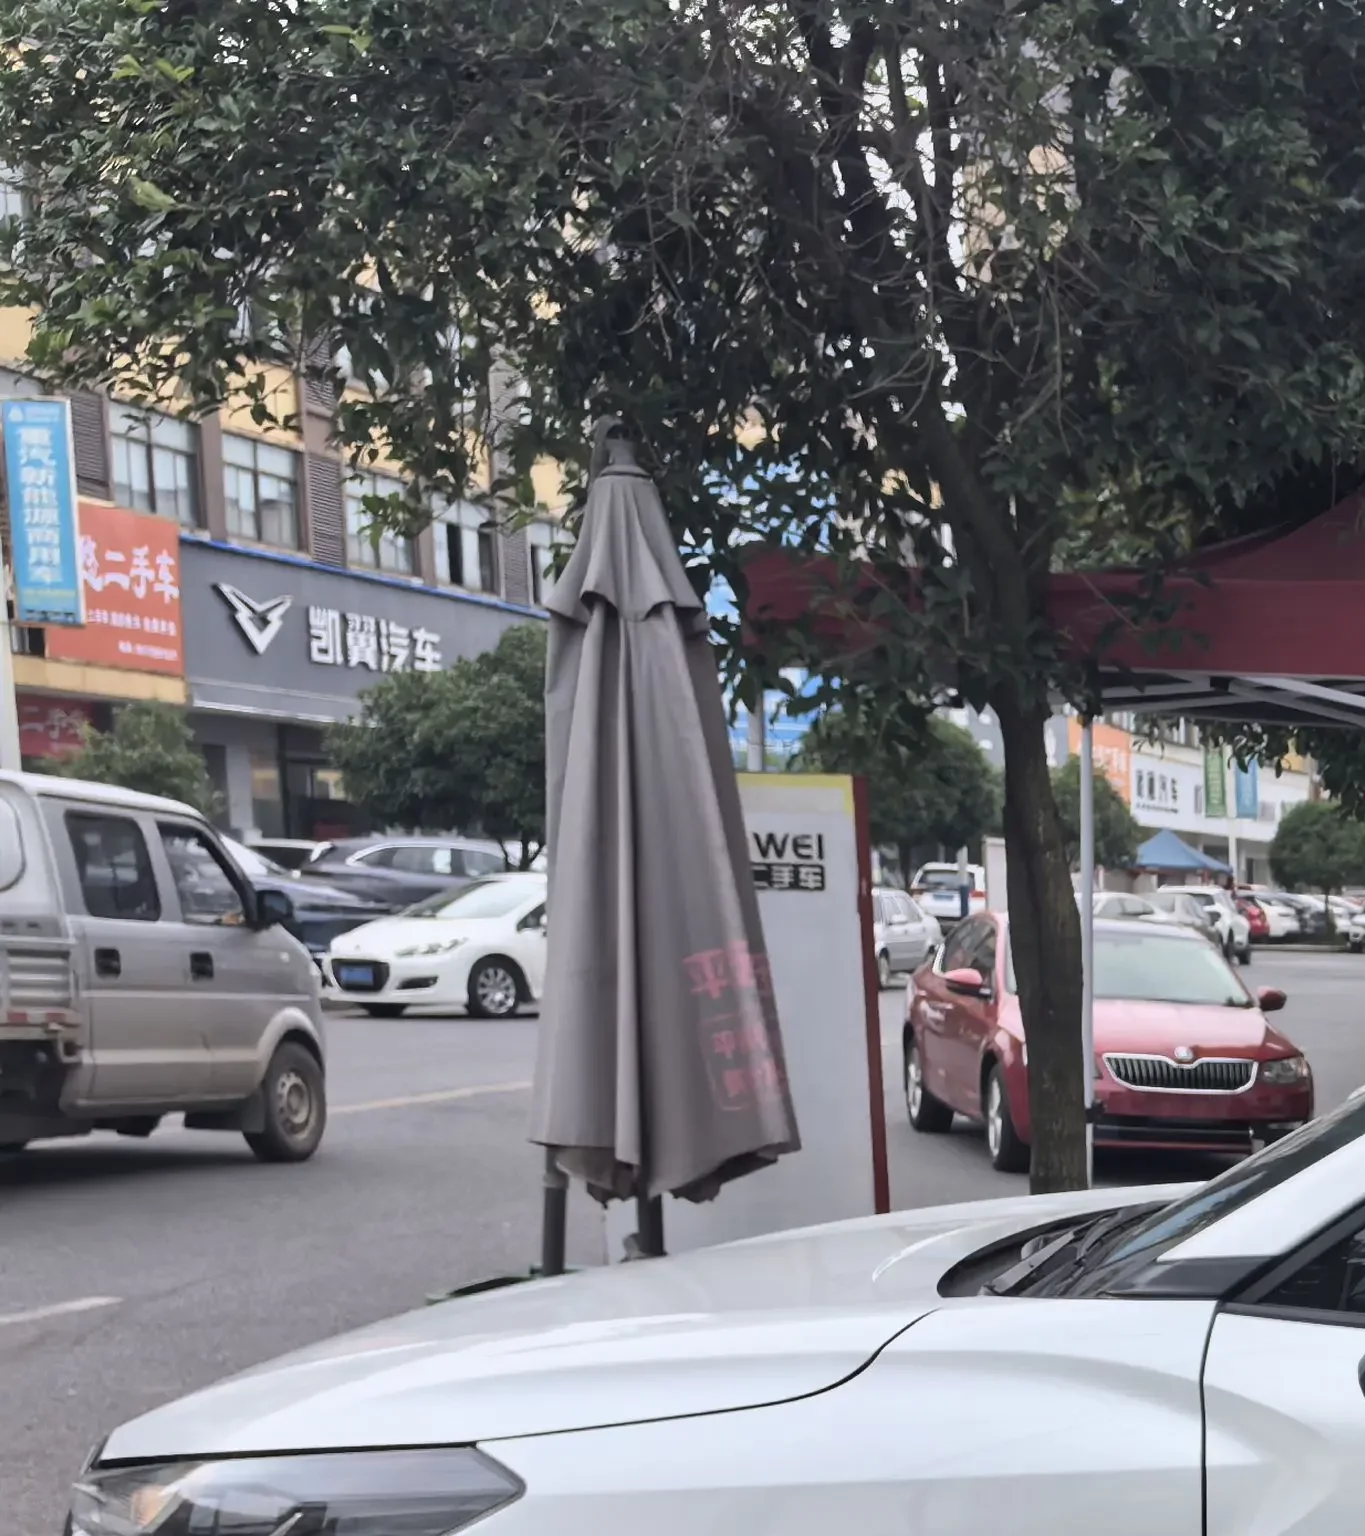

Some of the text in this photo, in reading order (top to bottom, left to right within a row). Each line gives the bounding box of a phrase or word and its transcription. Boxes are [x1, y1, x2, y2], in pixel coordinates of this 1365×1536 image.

[308, 605, 443, 673] 凯翼汽车
[752, 865, 823, 889] 二手车
